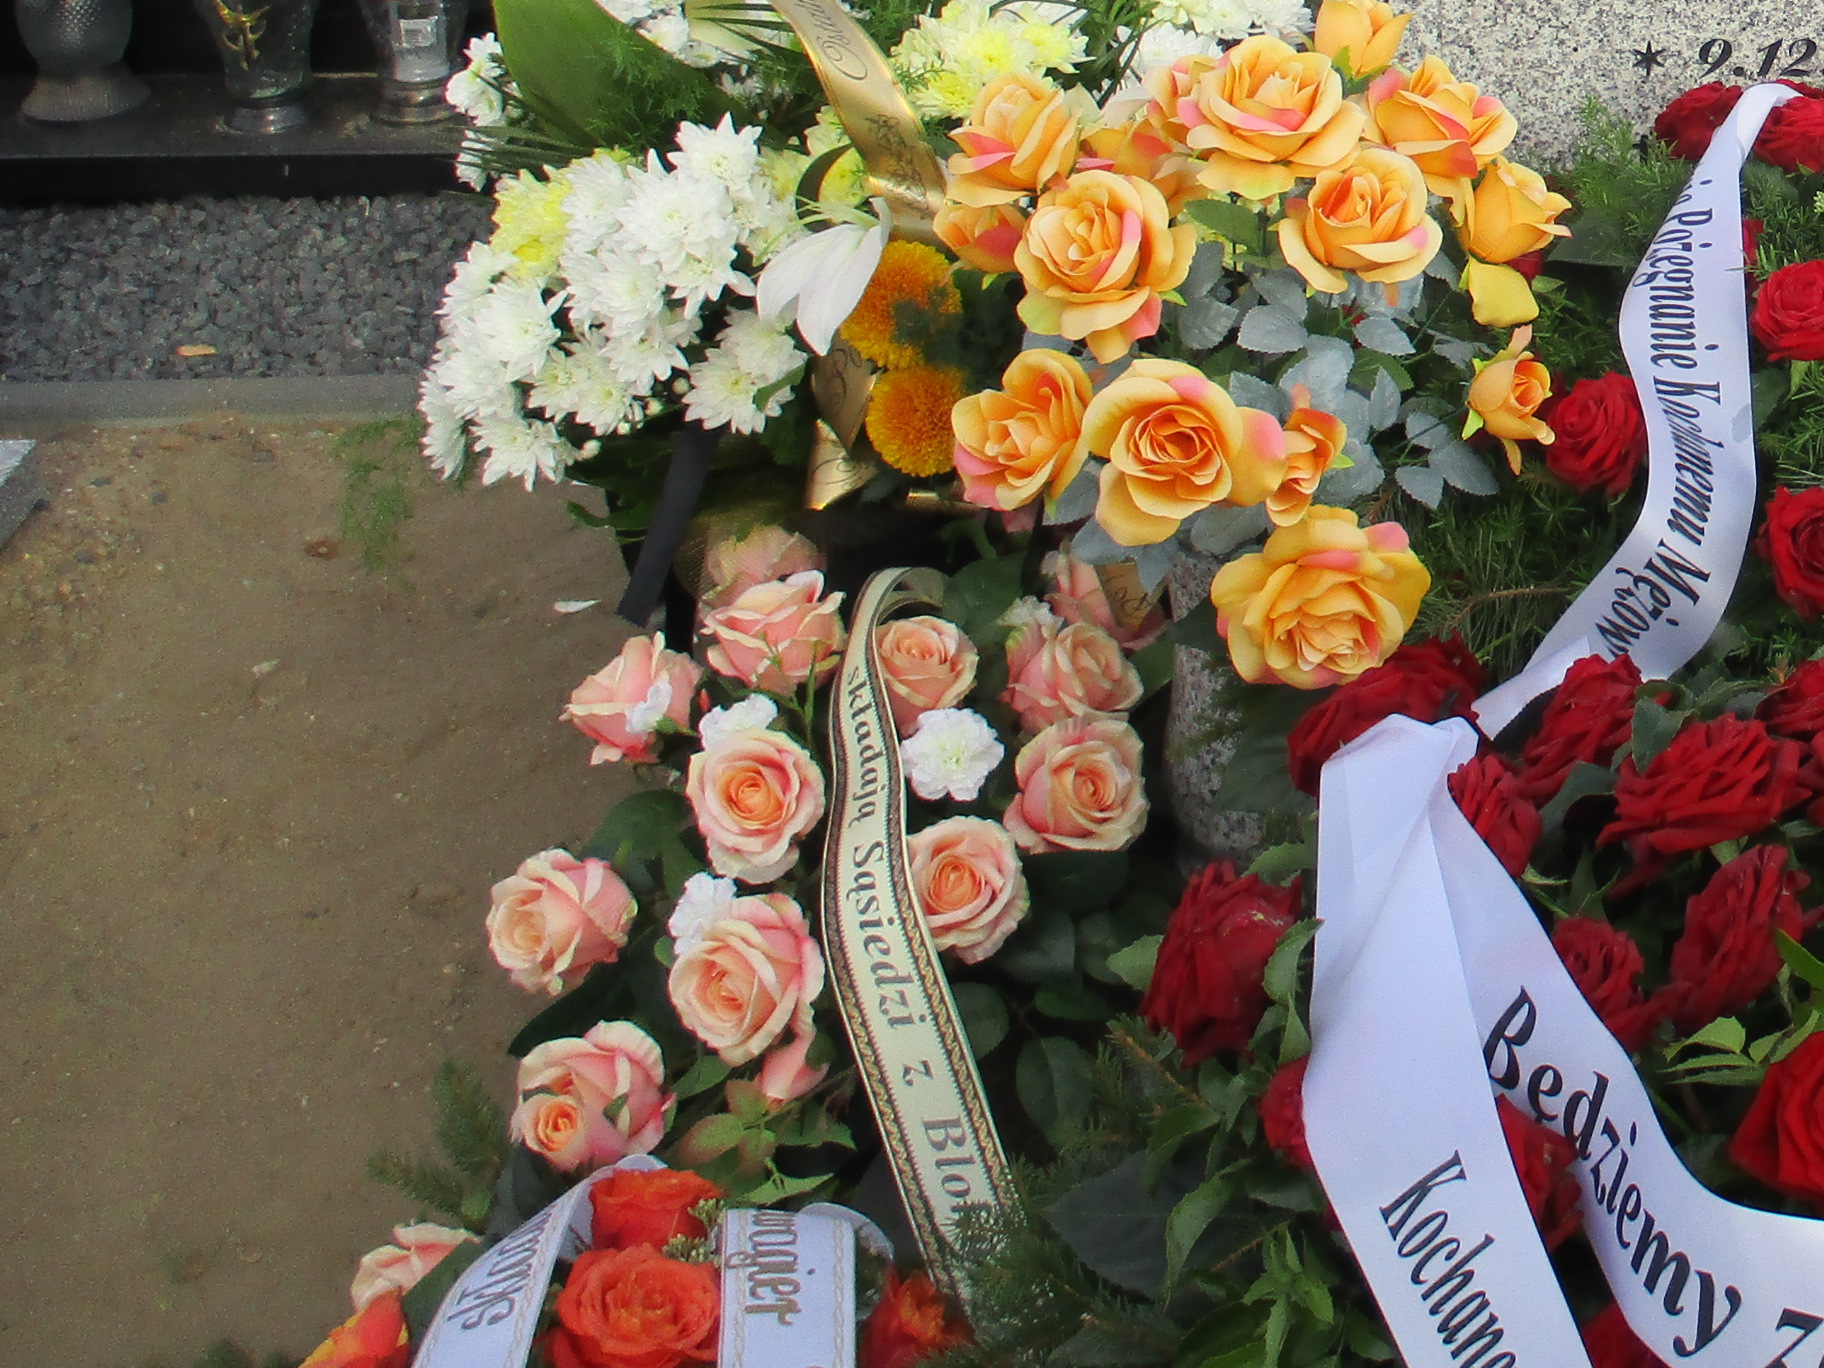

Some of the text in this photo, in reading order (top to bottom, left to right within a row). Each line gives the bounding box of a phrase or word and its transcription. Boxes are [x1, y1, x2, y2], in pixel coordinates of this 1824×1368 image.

[1633, 208, 1719, 369] Pożegnanie
[1653, 376, 1725, 546] Kochanemu
[846, 664, 887, 829] składają
[846, 840, 928, 1030] Sąsiedzi
[902, 1059, 934, 1087] z
[1483, 984, 1742, 1358] Będziemy
